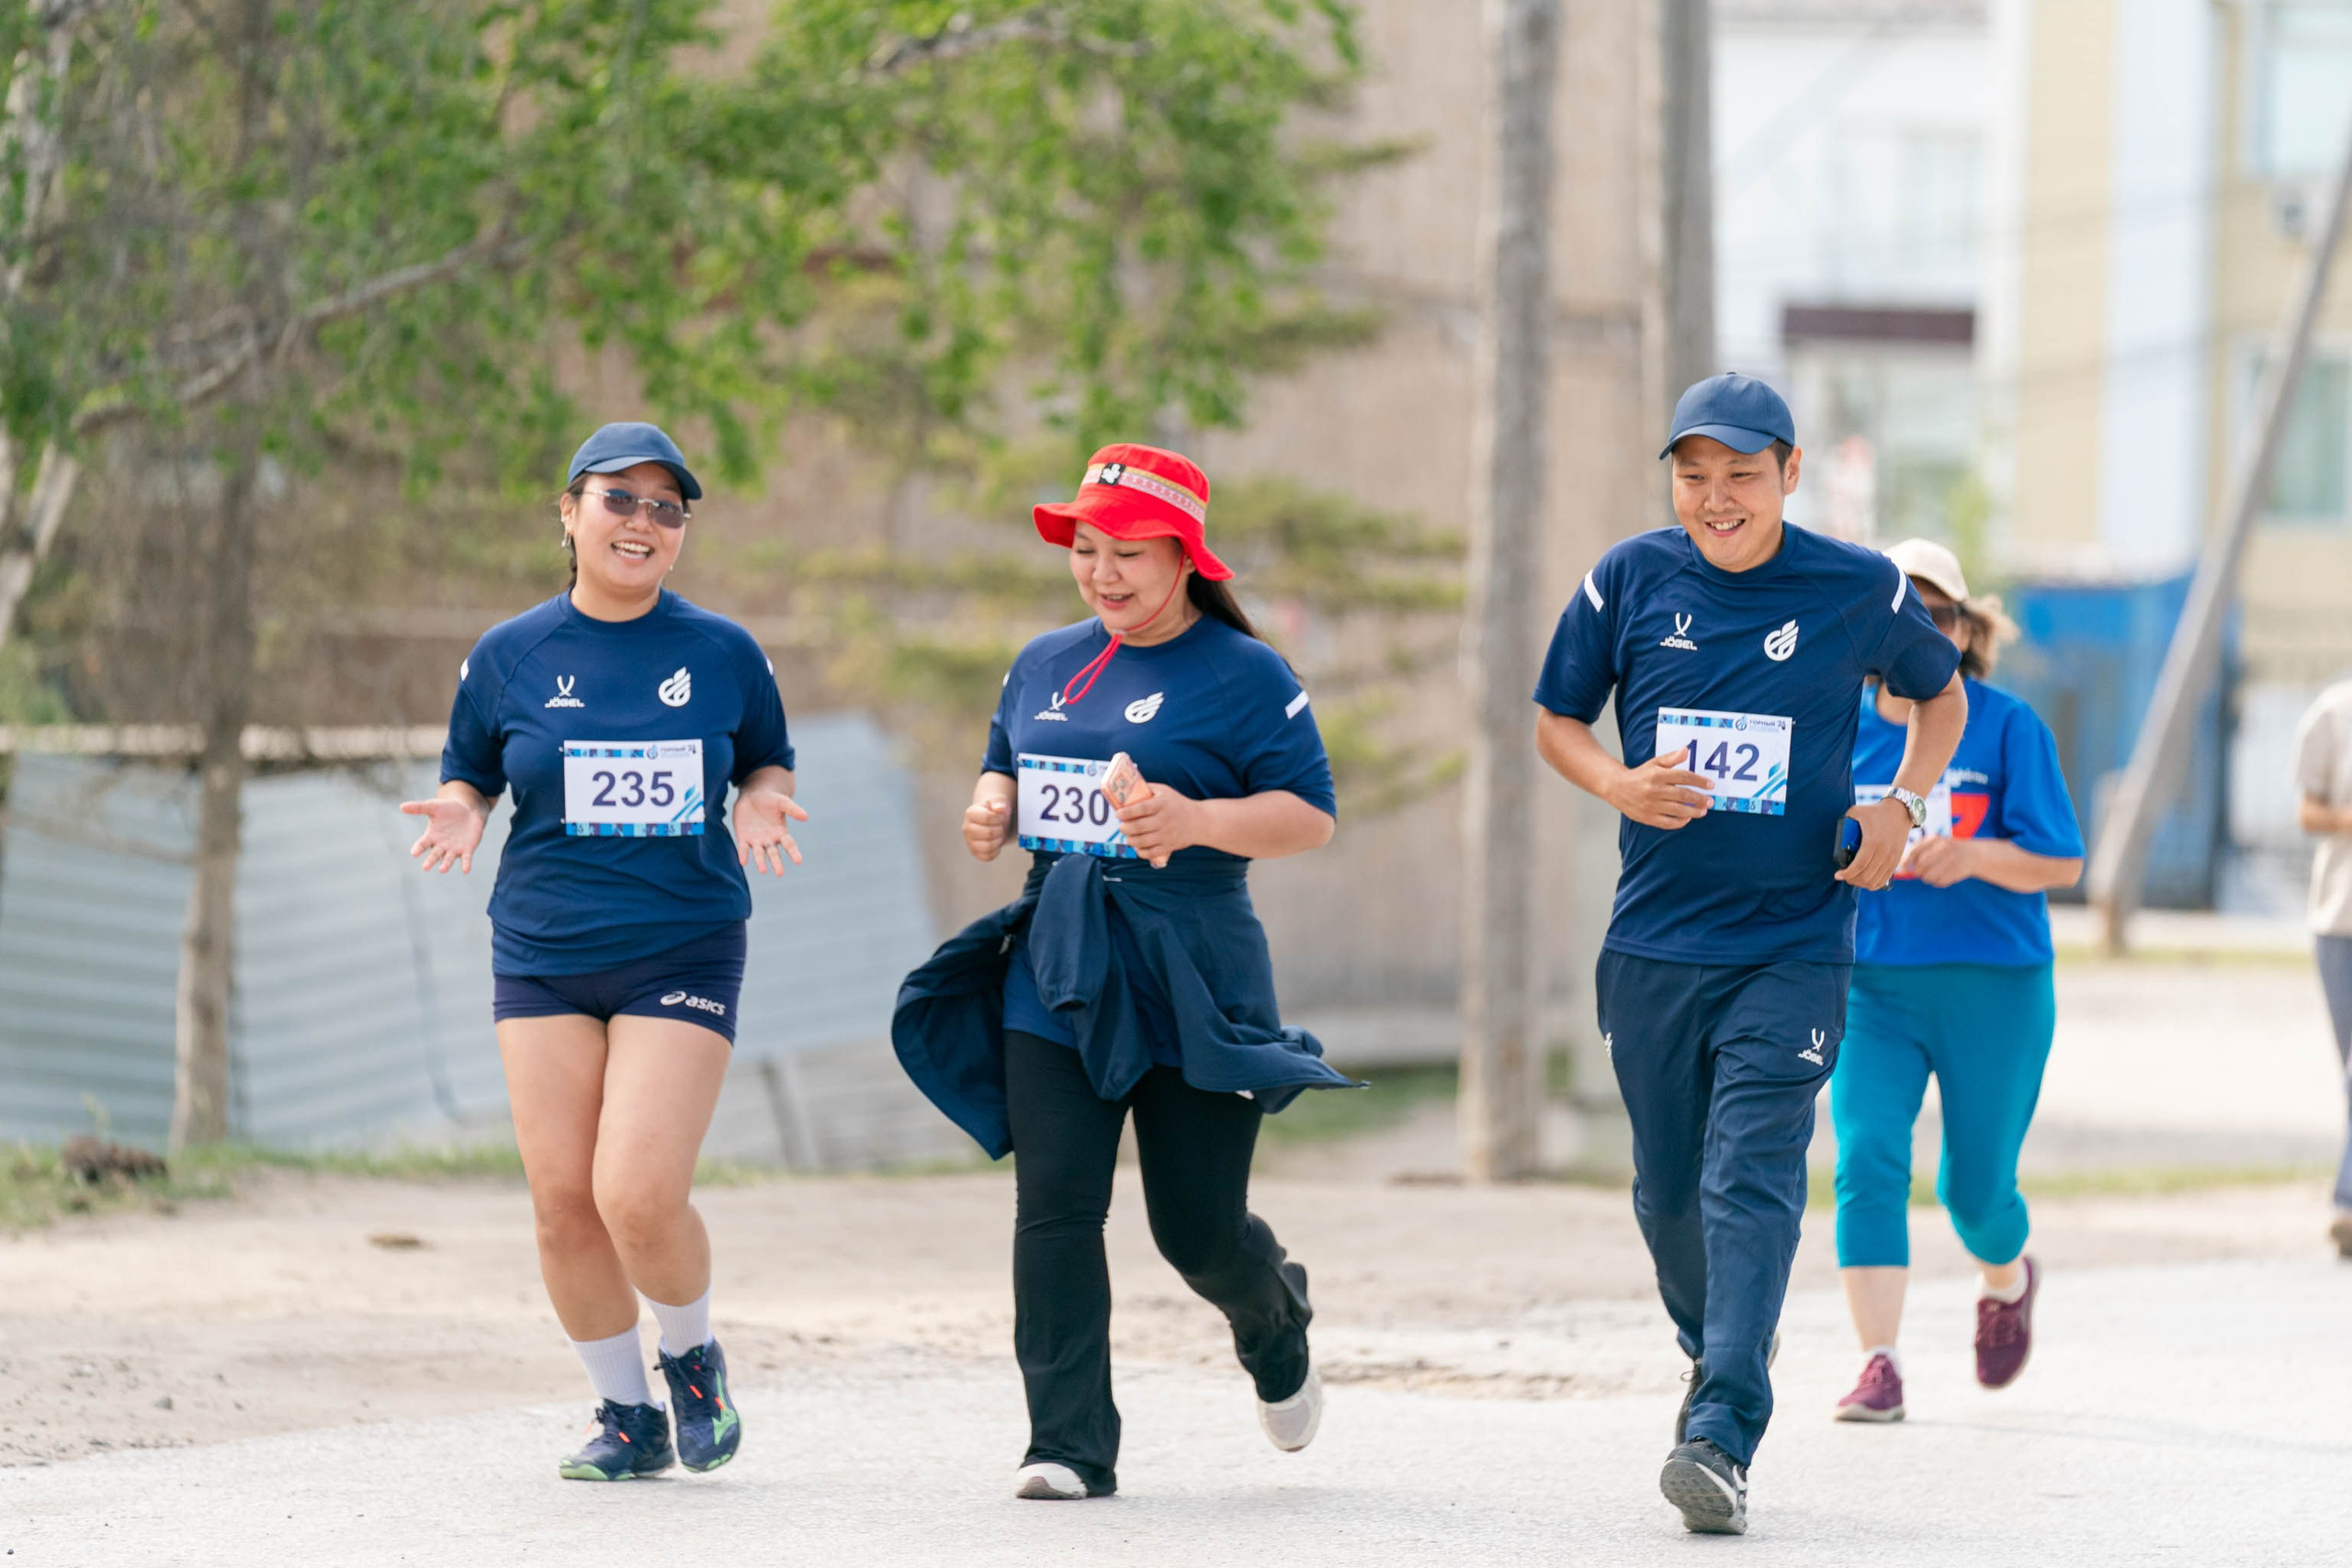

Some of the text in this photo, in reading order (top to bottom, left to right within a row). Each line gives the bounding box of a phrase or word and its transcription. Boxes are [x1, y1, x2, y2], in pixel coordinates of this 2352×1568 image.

[1686, 739, 1760, 782] 142
[592, 771, 675, 807] 235
[1040, 784, 1110, 826] 230
